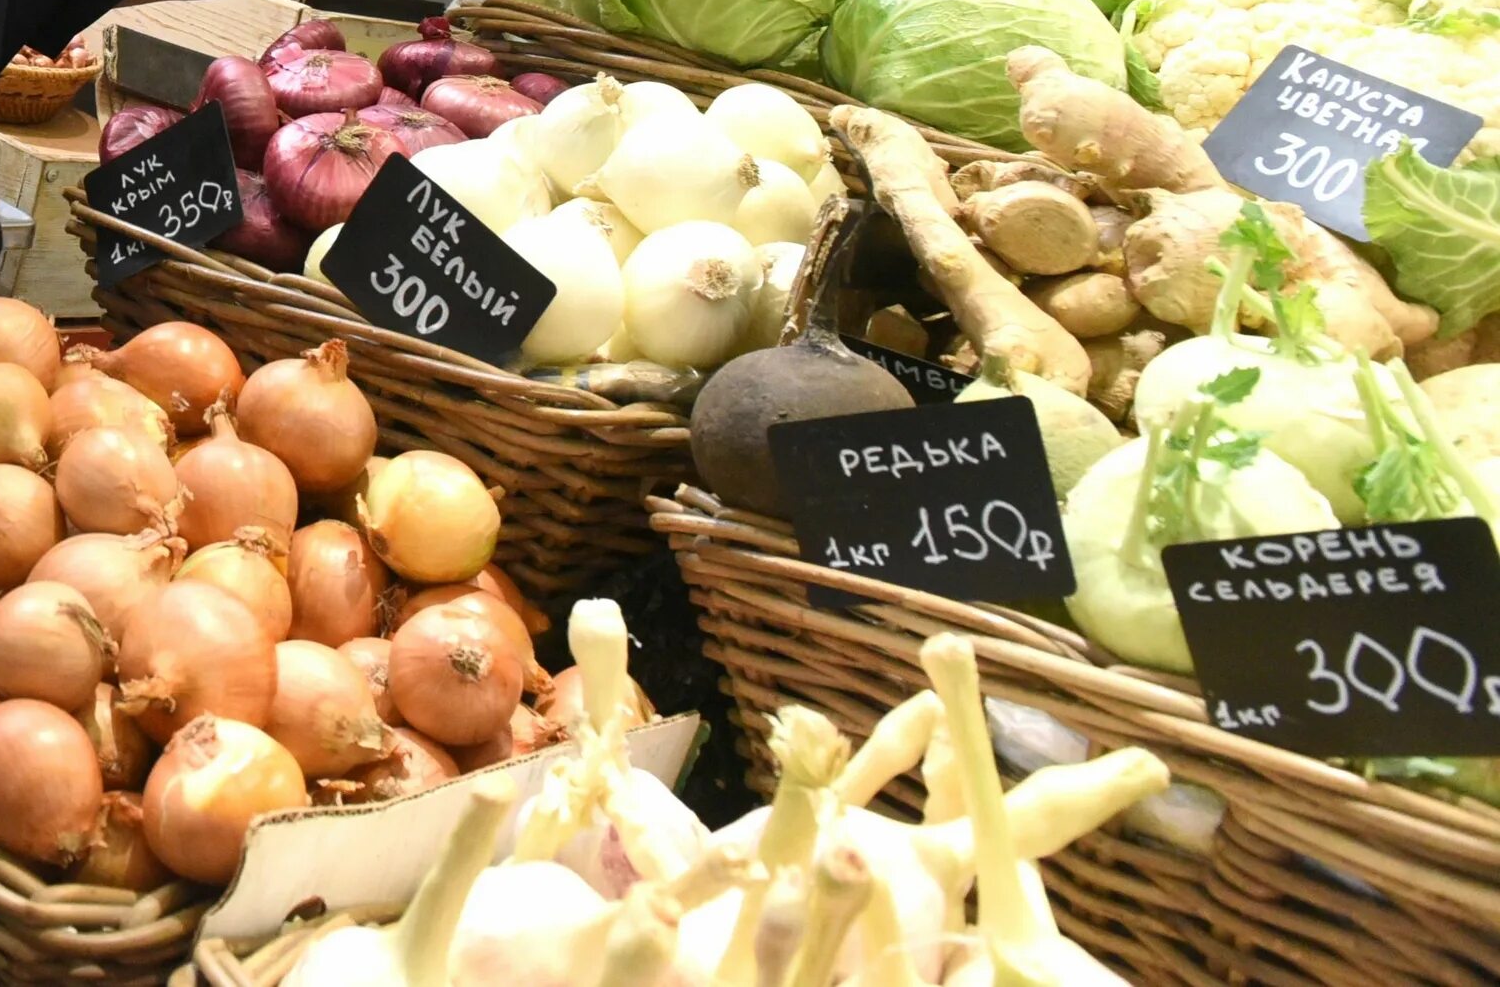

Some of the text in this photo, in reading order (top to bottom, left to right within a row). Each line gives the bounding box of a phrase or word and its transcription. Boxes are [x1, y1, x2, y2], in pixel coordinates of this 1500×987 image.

[1279, 52, 1425, 127] КАПУСТА
[120, 154, 164, 189] ЛУК
[1253, 132, 1359, 202] 300
[111, 170, 176, 215] КРЫМ
[406, 178, 467, 245] ЛУК
[370, 253, 450, 336] 300
[410, 224, 520, 326] БЕЛЫЙ
[839, 431, 1007, 479] РЕДЬКА
[824, 536, 891, 568] 1кг
[1219, 528, 1422, 570] КОРЕНЬ
[1188, 563, 1446, 602] СЕЛЬДЕРЕЯ
[1214, 699, 1282, 730] 1кг
